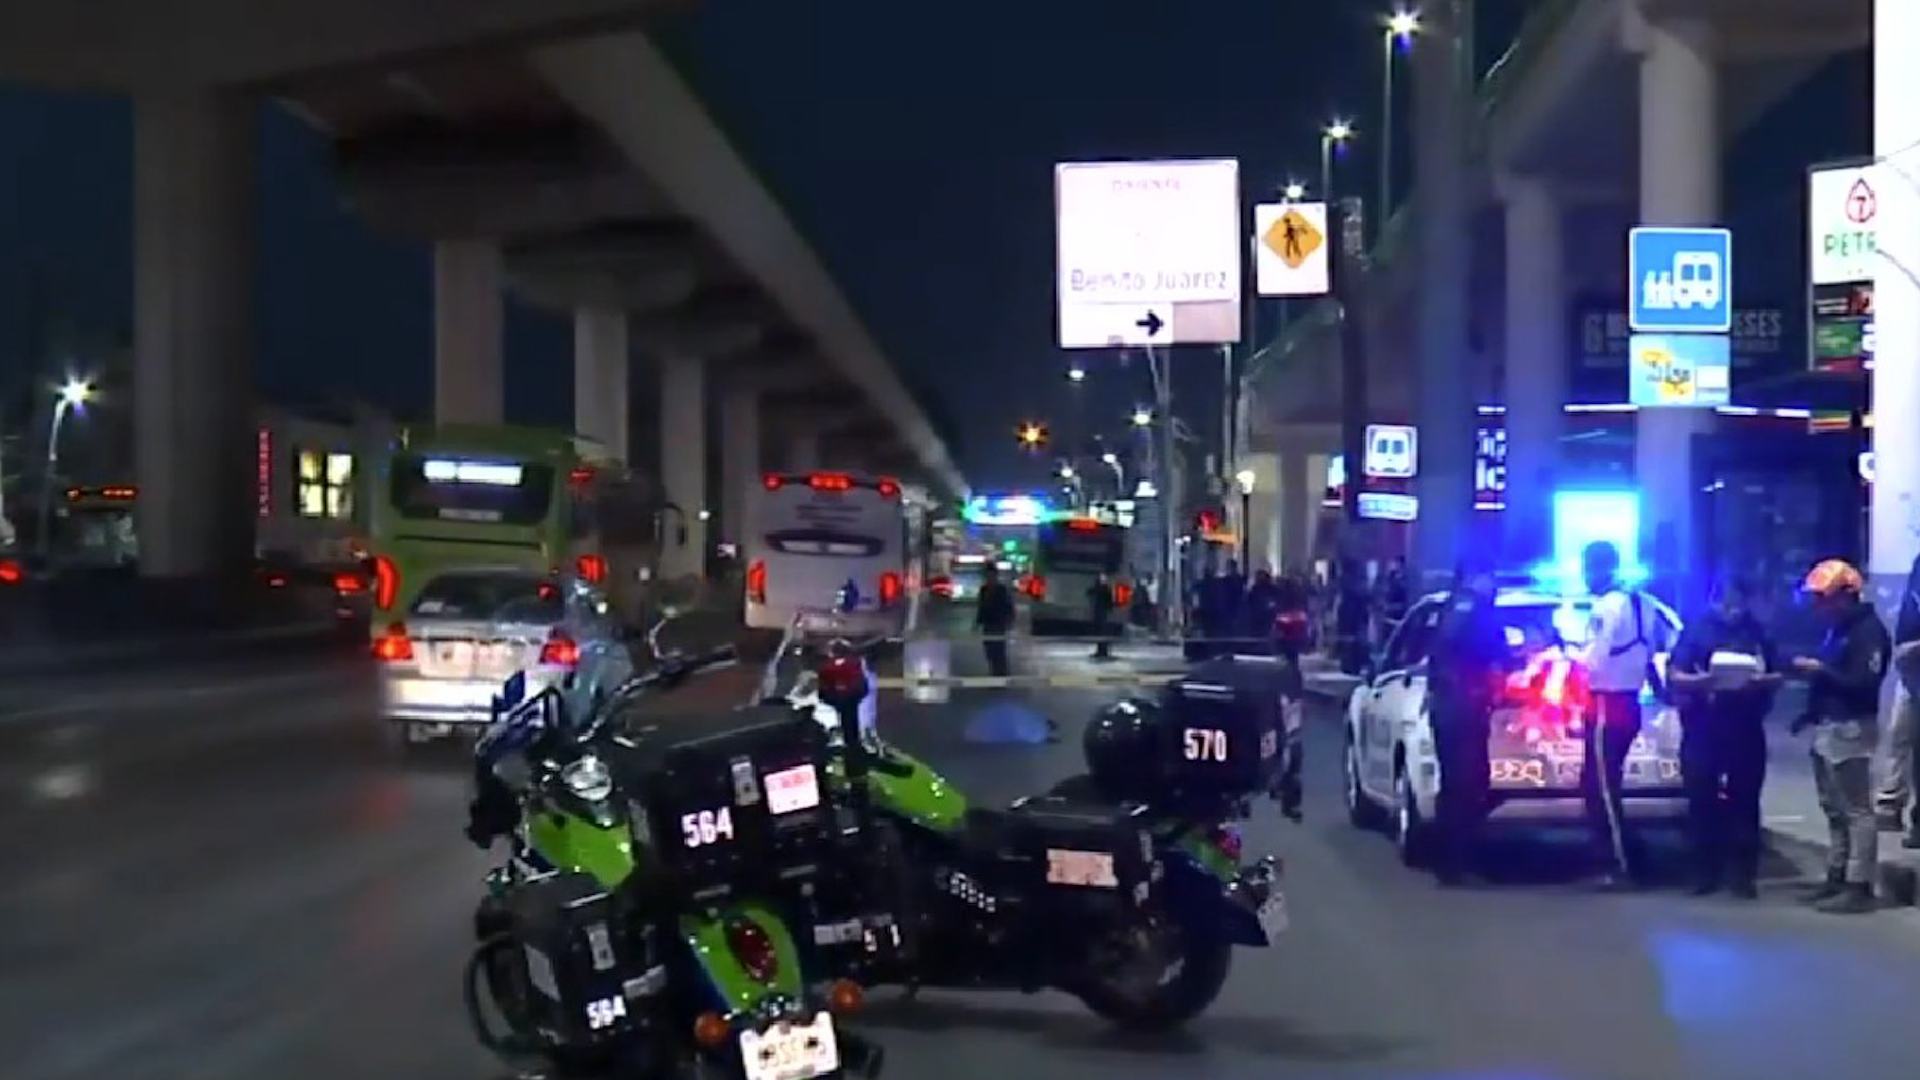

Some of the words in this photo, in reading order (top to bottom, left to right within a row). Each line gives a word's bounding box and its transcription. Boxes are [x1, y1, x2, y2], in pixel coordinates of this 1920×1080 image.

[1183, 728, 1227, 762] 570
[682, 807, 733, 847] 564
[586, 995, 626, 1029] 564
